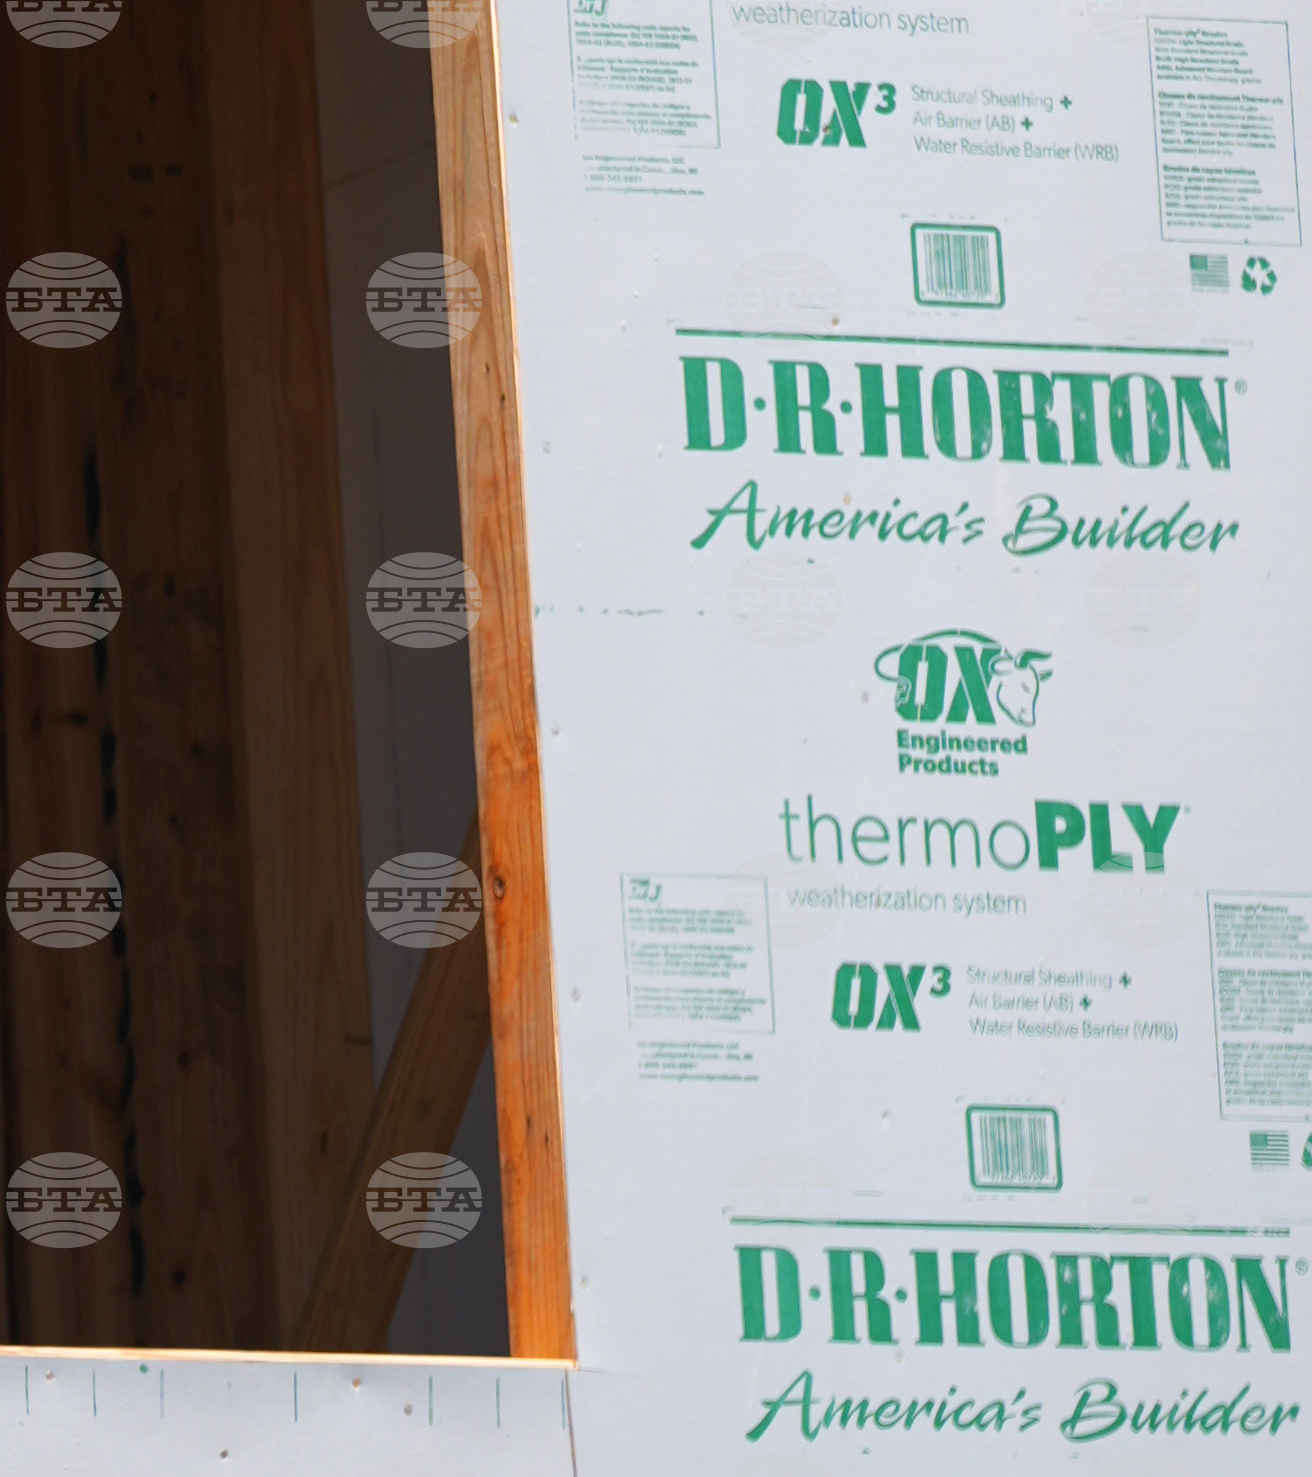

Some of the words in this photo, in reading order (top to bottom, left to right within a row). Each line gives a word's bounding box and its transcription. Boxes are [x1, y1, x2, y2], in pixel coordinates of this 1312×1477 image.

[733, 2, 892, 31] weatherization
[893, 11, 970, 39] system
[691, 480, 984, 552] America's
[1003, 496, 1238, 557] Builder
[896, 635, 1001, 725] OX
[897, 730, 1027, 756] Engineered
[783, 797, 1179, 872] thermoPLY
[747, 1371, 1040, 1442] America's
[1061, 1382, 1299, 1442] Builder
